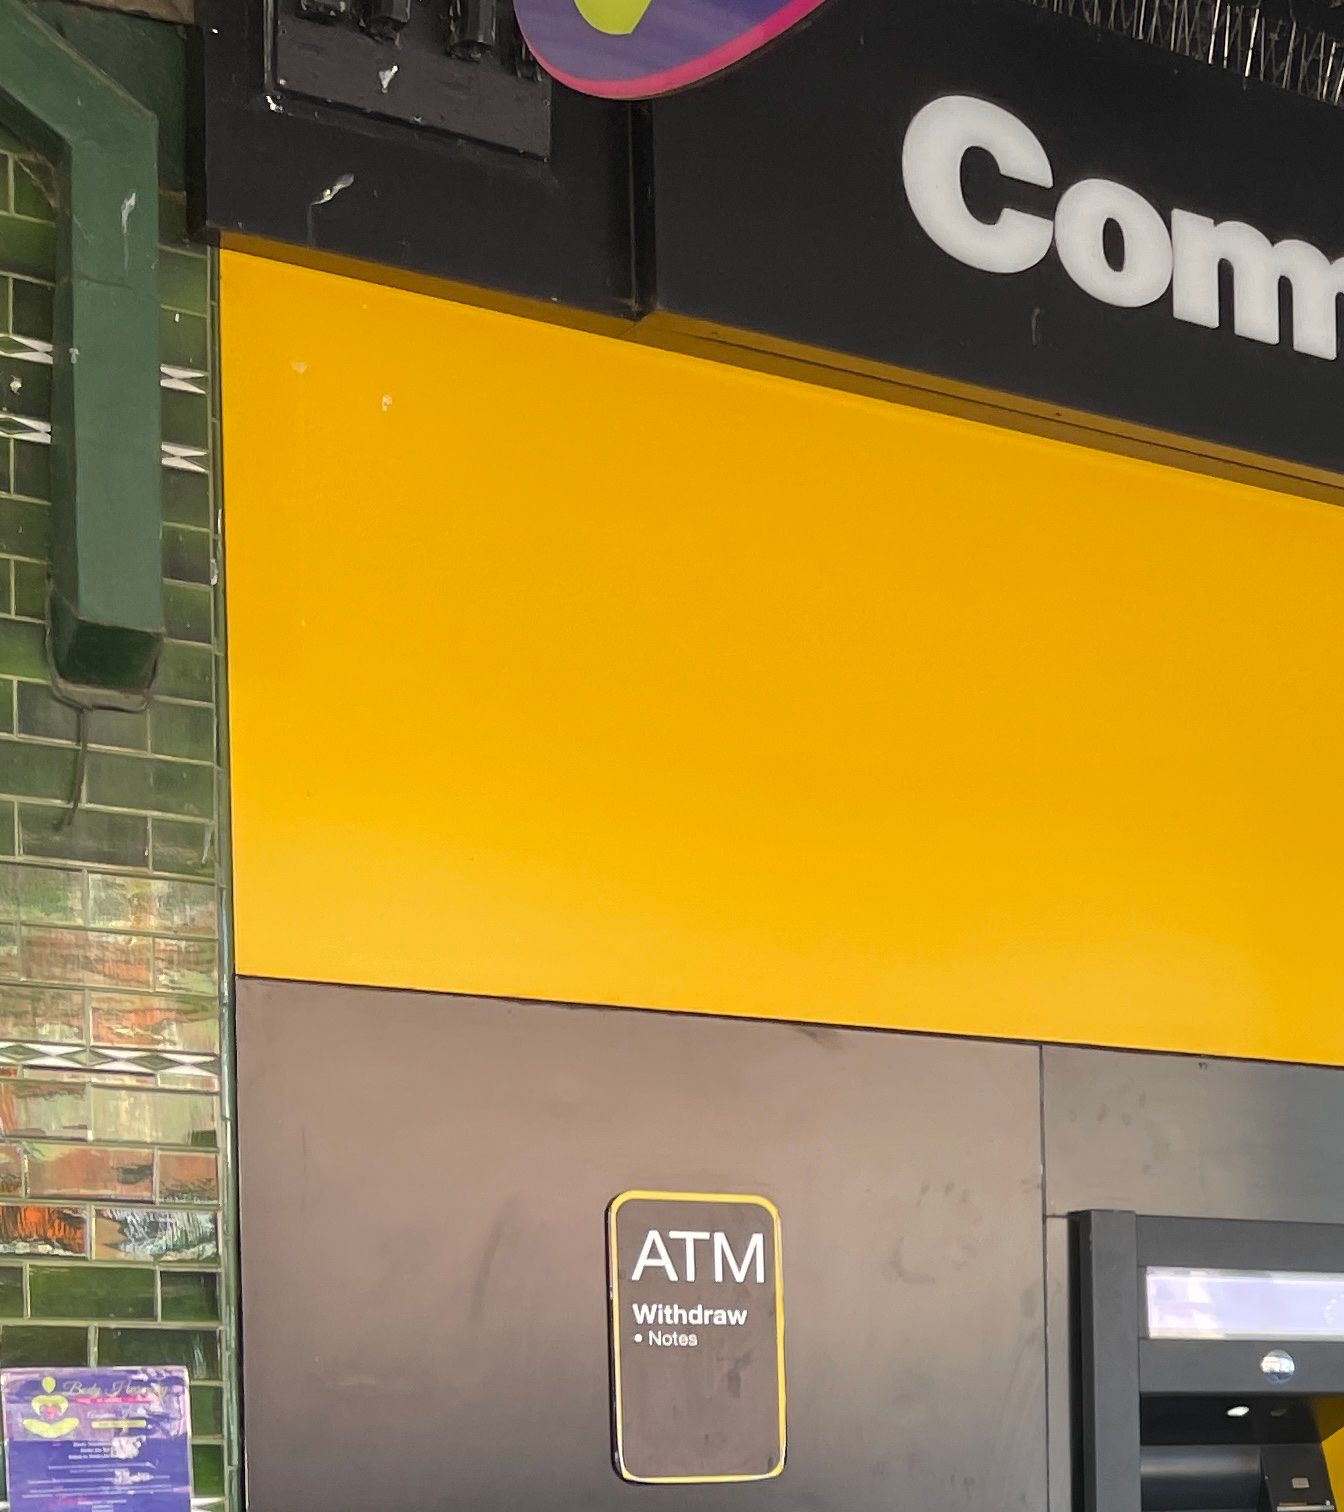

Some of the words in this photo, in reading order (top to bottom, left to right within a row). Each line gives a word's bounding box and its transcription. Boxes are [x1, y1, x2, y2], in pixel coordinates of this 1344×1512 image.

[631, 1230, 765, 1283] ATM
[632, 1303, 748, 1325] Withdraw
[648, 1330, 698, 1347] Notes
